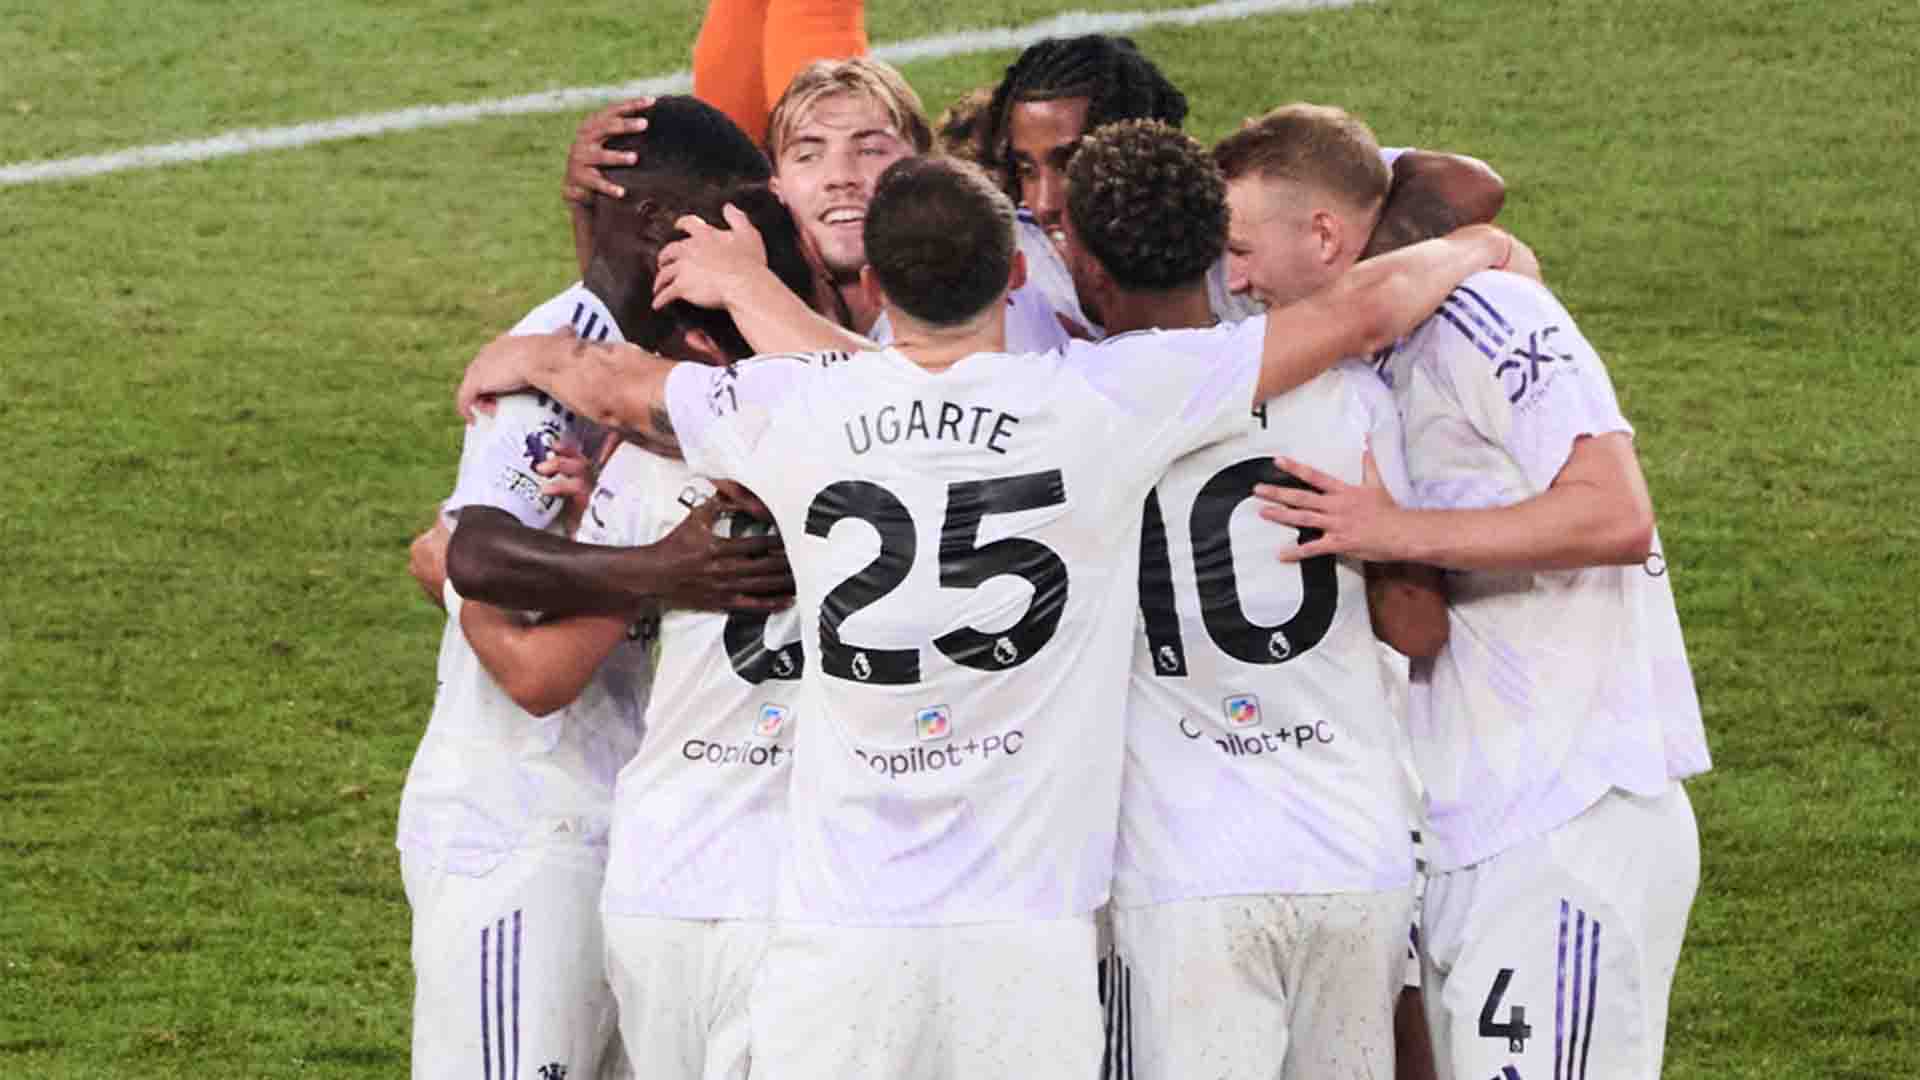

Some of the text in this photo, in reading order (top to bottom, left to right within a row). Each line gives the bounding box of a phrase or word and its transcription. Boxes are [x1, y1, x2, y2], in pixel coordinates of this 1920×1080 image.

[845, 399, 1020, 455] UGARTE
[804, 468, 1069, 685] 25
[1138, 456, 1339, 677] 10
[1478, 967, 1532, 1053] 4
